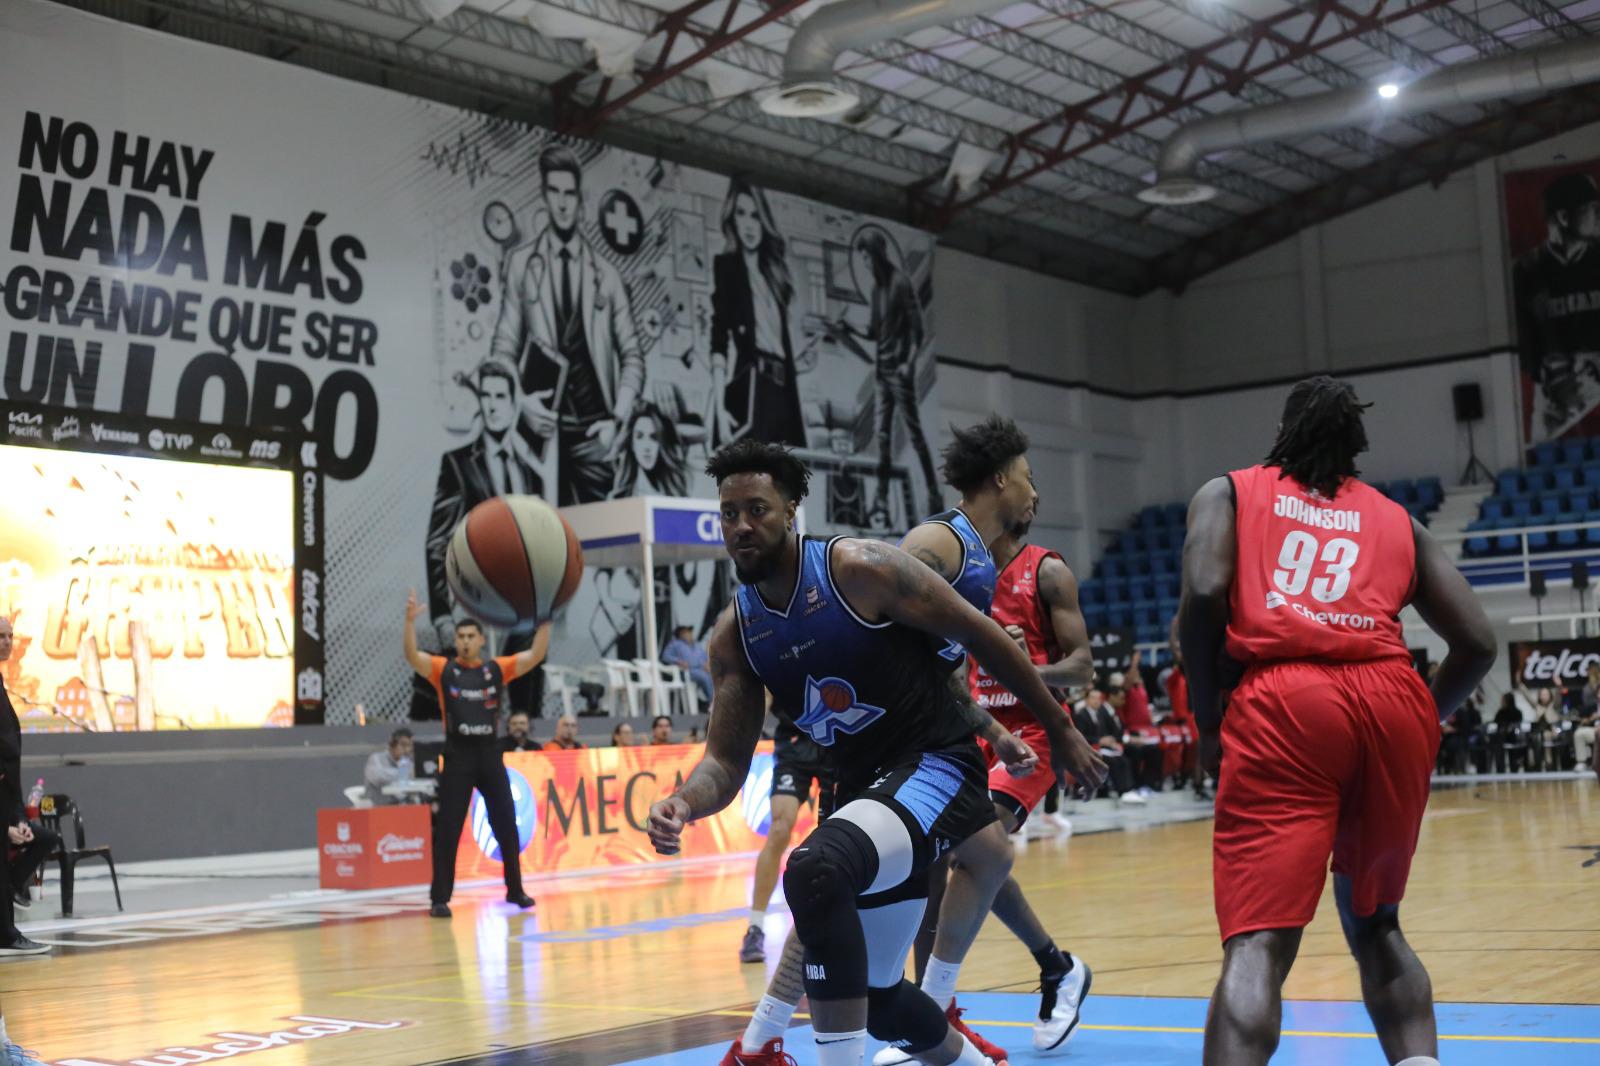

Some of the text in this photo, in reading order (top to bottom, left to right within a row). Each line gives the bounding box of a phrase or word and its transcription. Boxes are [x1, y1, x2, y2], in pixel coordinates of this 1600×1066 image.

[18, 110, 215, 201] NO HAY
[10, 173, 367, 305] NADA MÁS
[4, 265, 379, 367] GRANDE QUE SER
[3, 330, 102, 409] UN
[8, 423, 43, 438] Pacific
[164, 432, 194, 450] TVP
[303, 471, 317, 546] Chevron
[1273, 494, 1361, 533] JOHNSON
[1273, 530, 1360, 603] 93
[302, 569, 320, 642] telcel
[1292, 603, 1375, 631] Chevron
[805, 963, 827, 980] NBA
